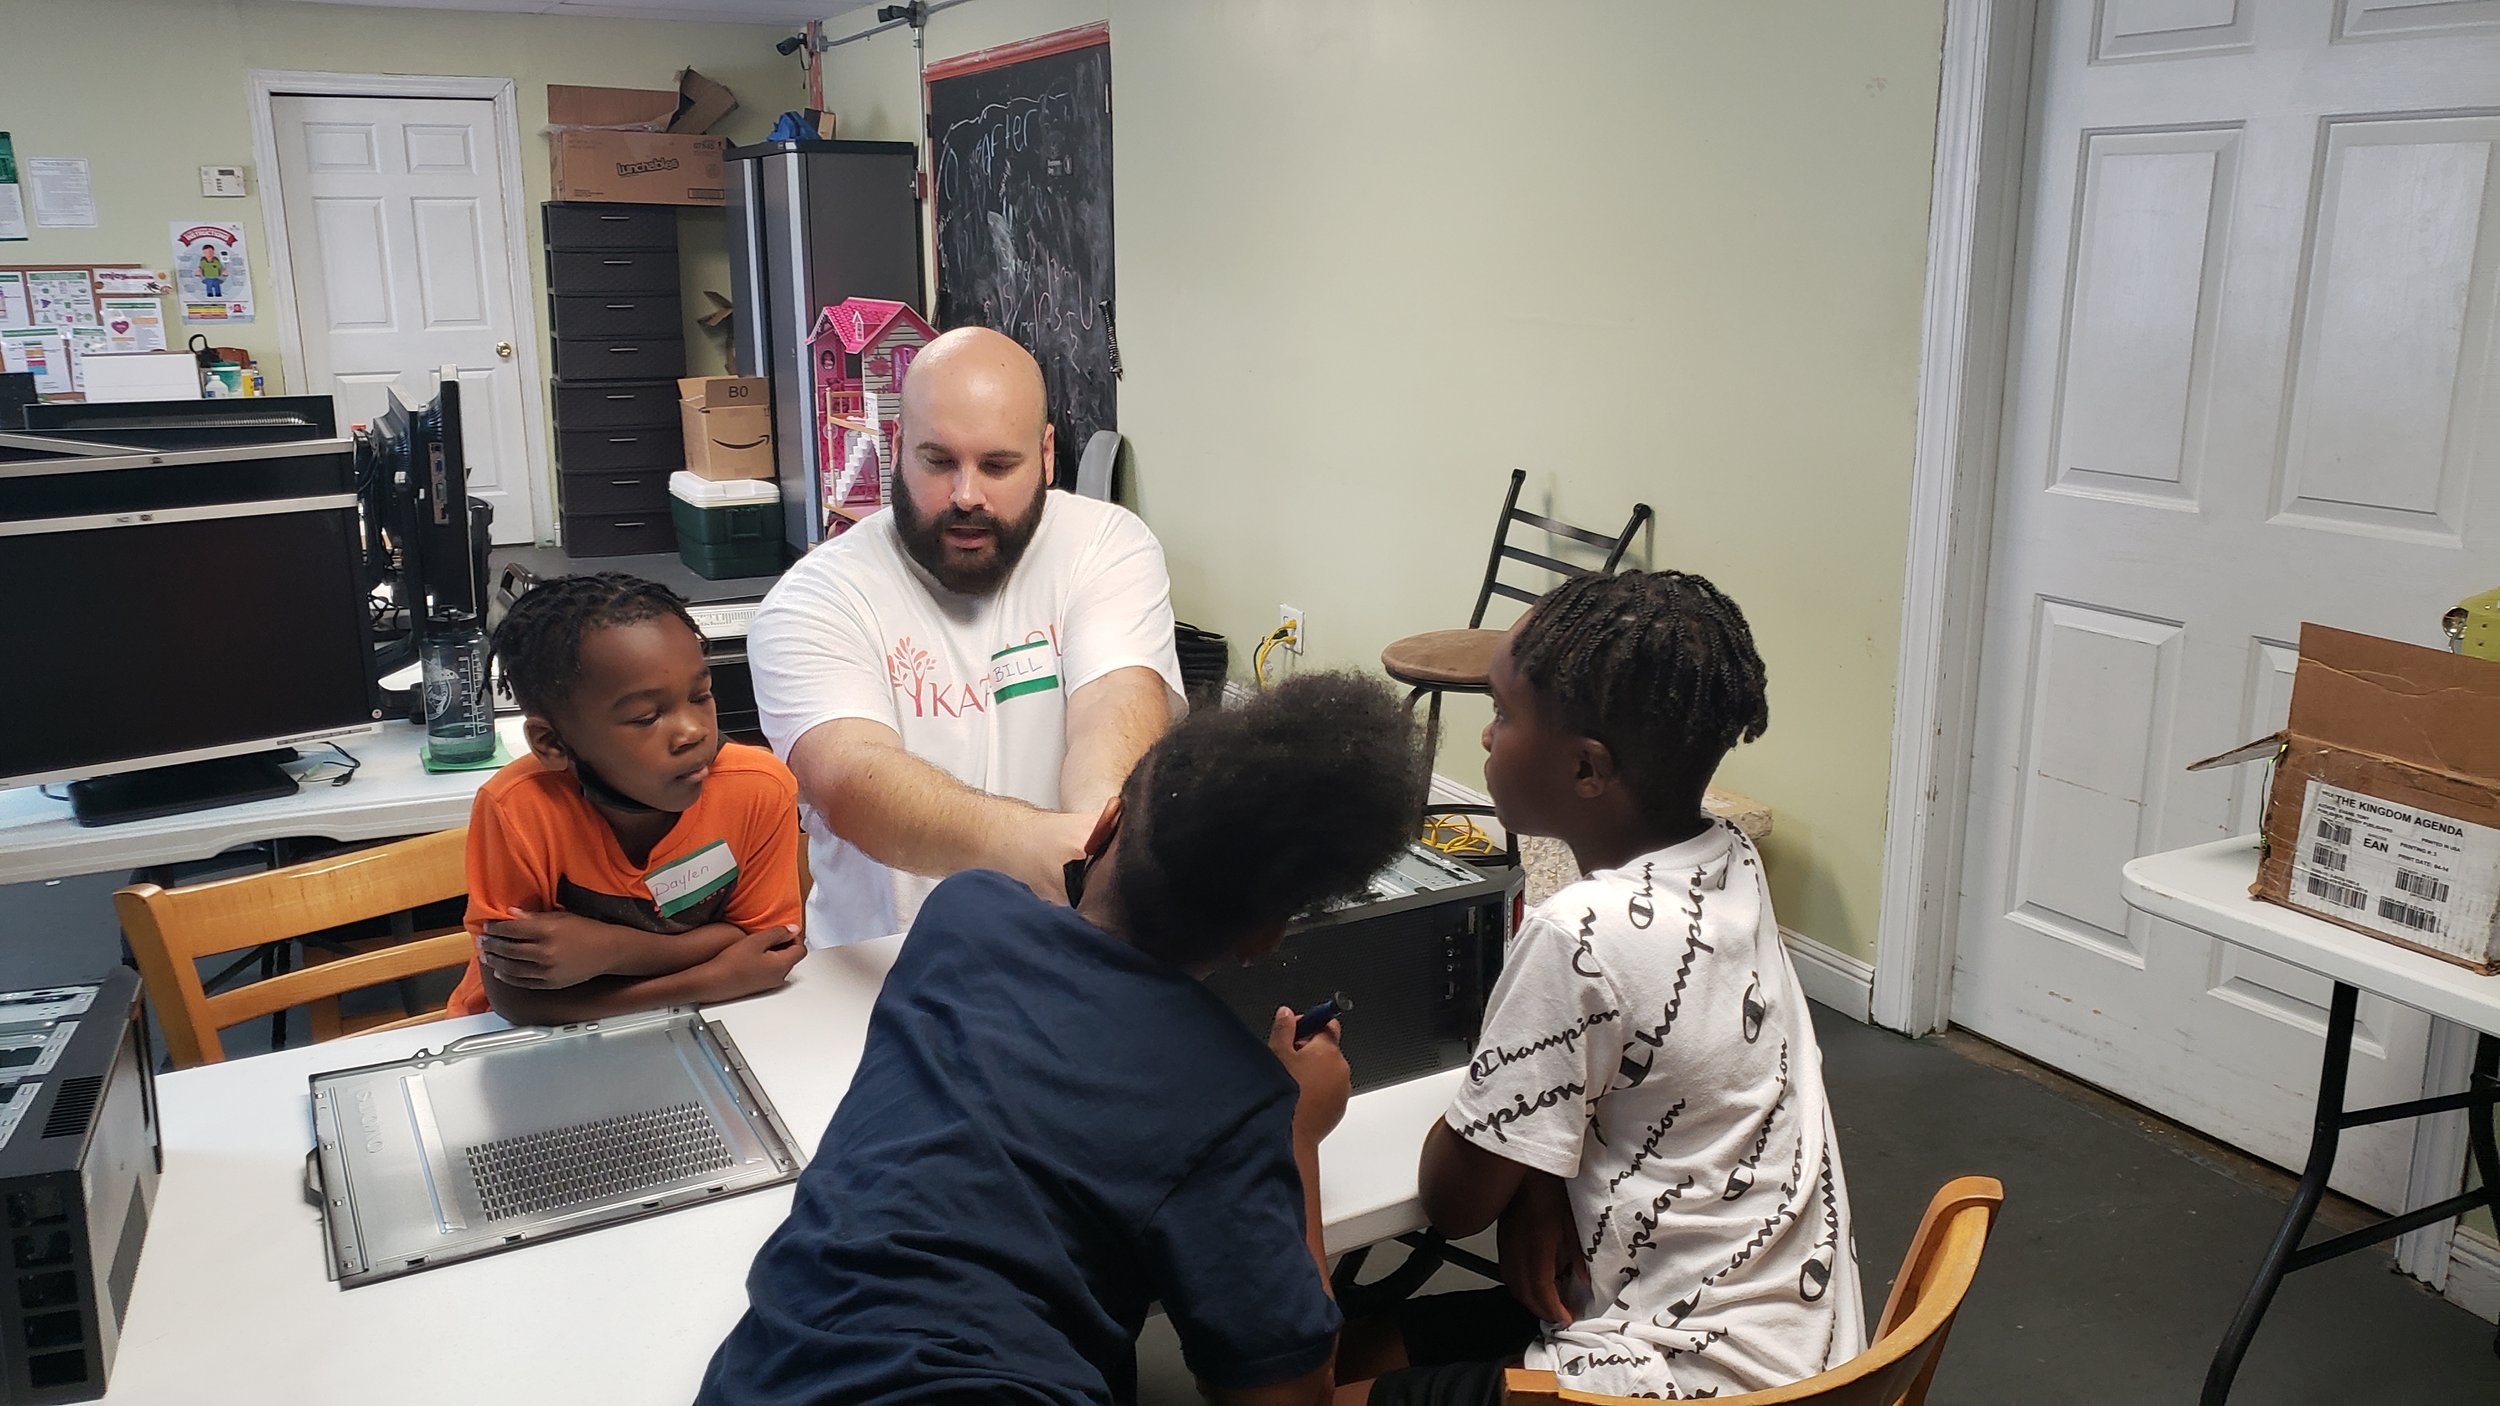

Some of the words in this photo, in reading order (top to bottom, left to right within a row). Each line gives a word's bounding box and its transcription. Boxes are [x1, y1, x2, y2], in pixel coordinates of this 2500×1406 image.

[992, 657, 1043, 683] BILL
[2335, 794, 2356, 808] THE
[2358, 801, 2412, 824] KINGDOM
[2413, 817, 2464, 838] AGENDA
[2363, 837, 2389, 854] EAN
[652, 865, 710, 897] Daylen
[1469, 1009, 1620, 1086] Champion
